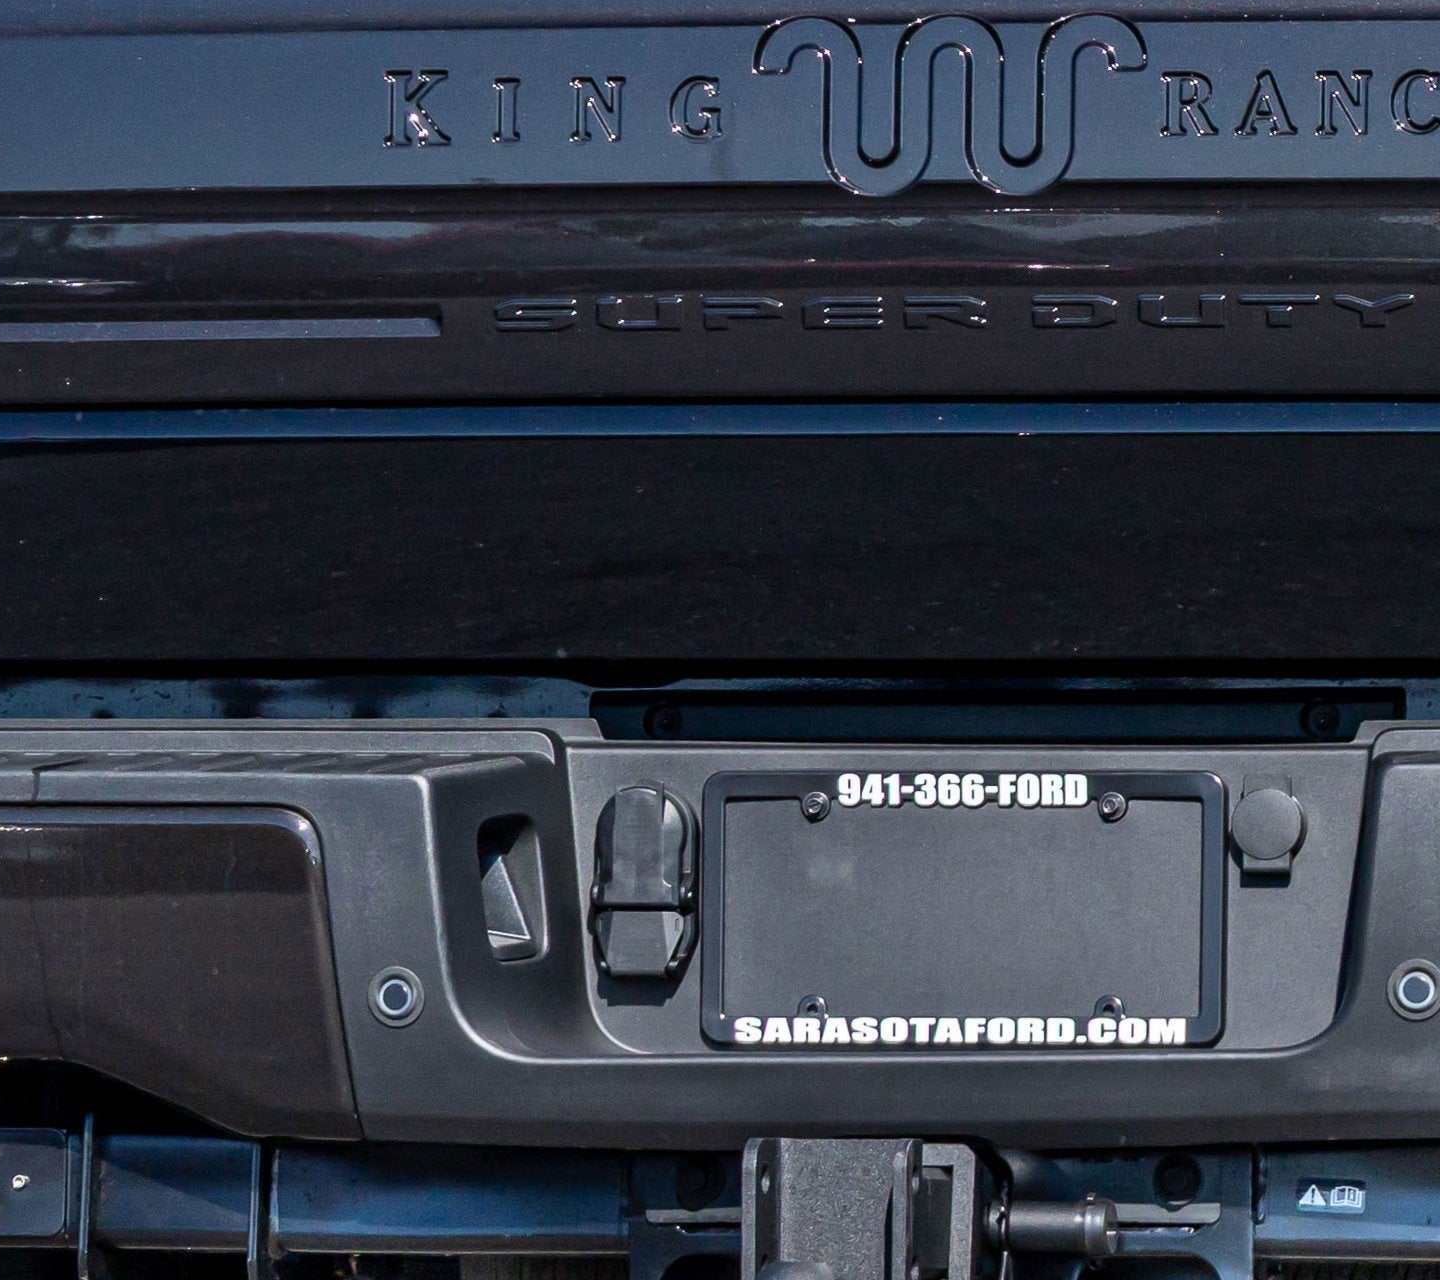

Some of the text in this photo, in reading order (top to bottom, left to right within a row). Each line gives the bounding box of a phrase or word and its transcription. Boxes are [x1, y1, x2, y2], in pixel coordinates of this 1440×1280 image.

[382, 68, 725, 147] KING
[494, 294, 1416, 332] SUPER DUTY
[836, 772, 1090, 809] 941-366-FORD
[733, 1016, 1188, 1045] SARASOTAFORD.COM
